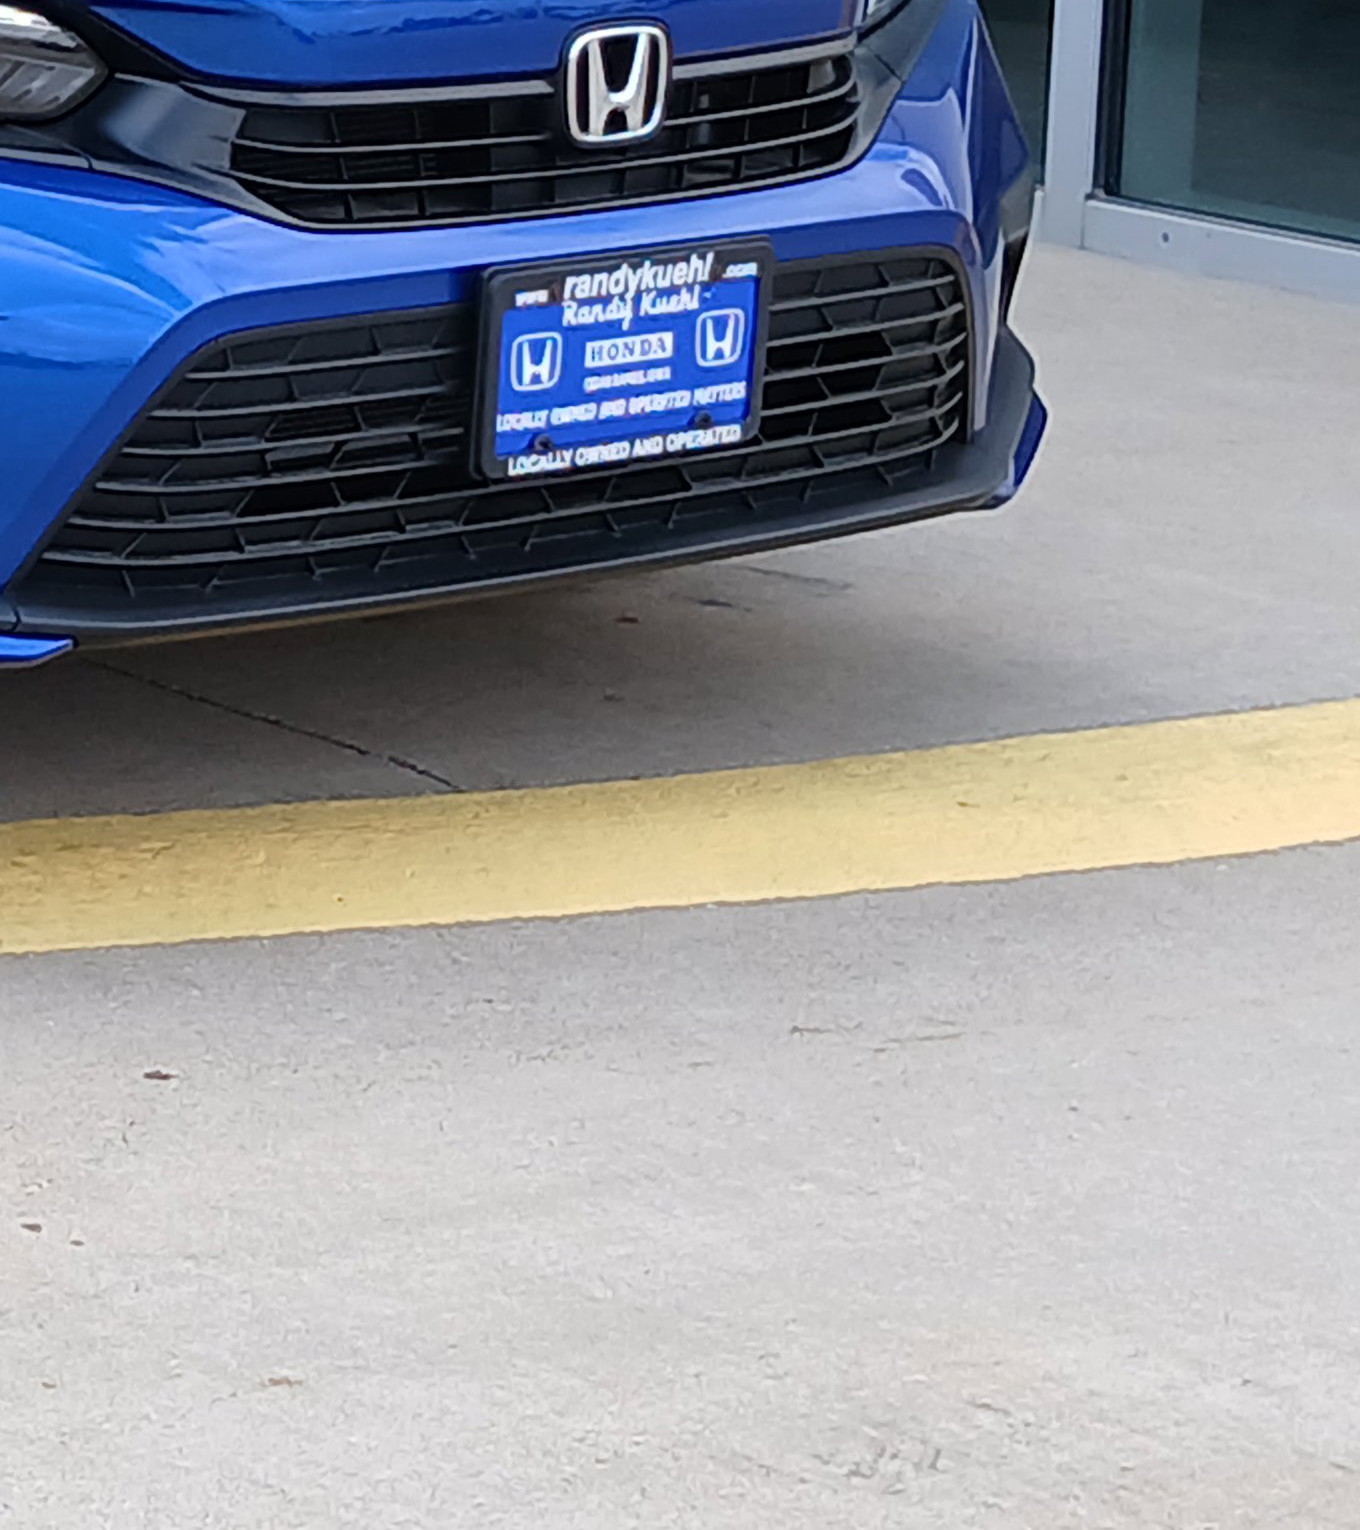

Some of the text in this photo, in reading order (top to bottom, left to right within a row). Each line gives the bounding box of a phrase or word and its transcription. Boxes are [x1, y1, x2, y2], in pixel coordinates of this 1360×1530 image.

[563, 252, 715, 299] randykuehl
[562, 285, 701, 331] Randy Kuehl
[590, 338, 668, 363] HONDA
[507, 424, 742, 478] LOCALLY OWNED AND OPERATED
